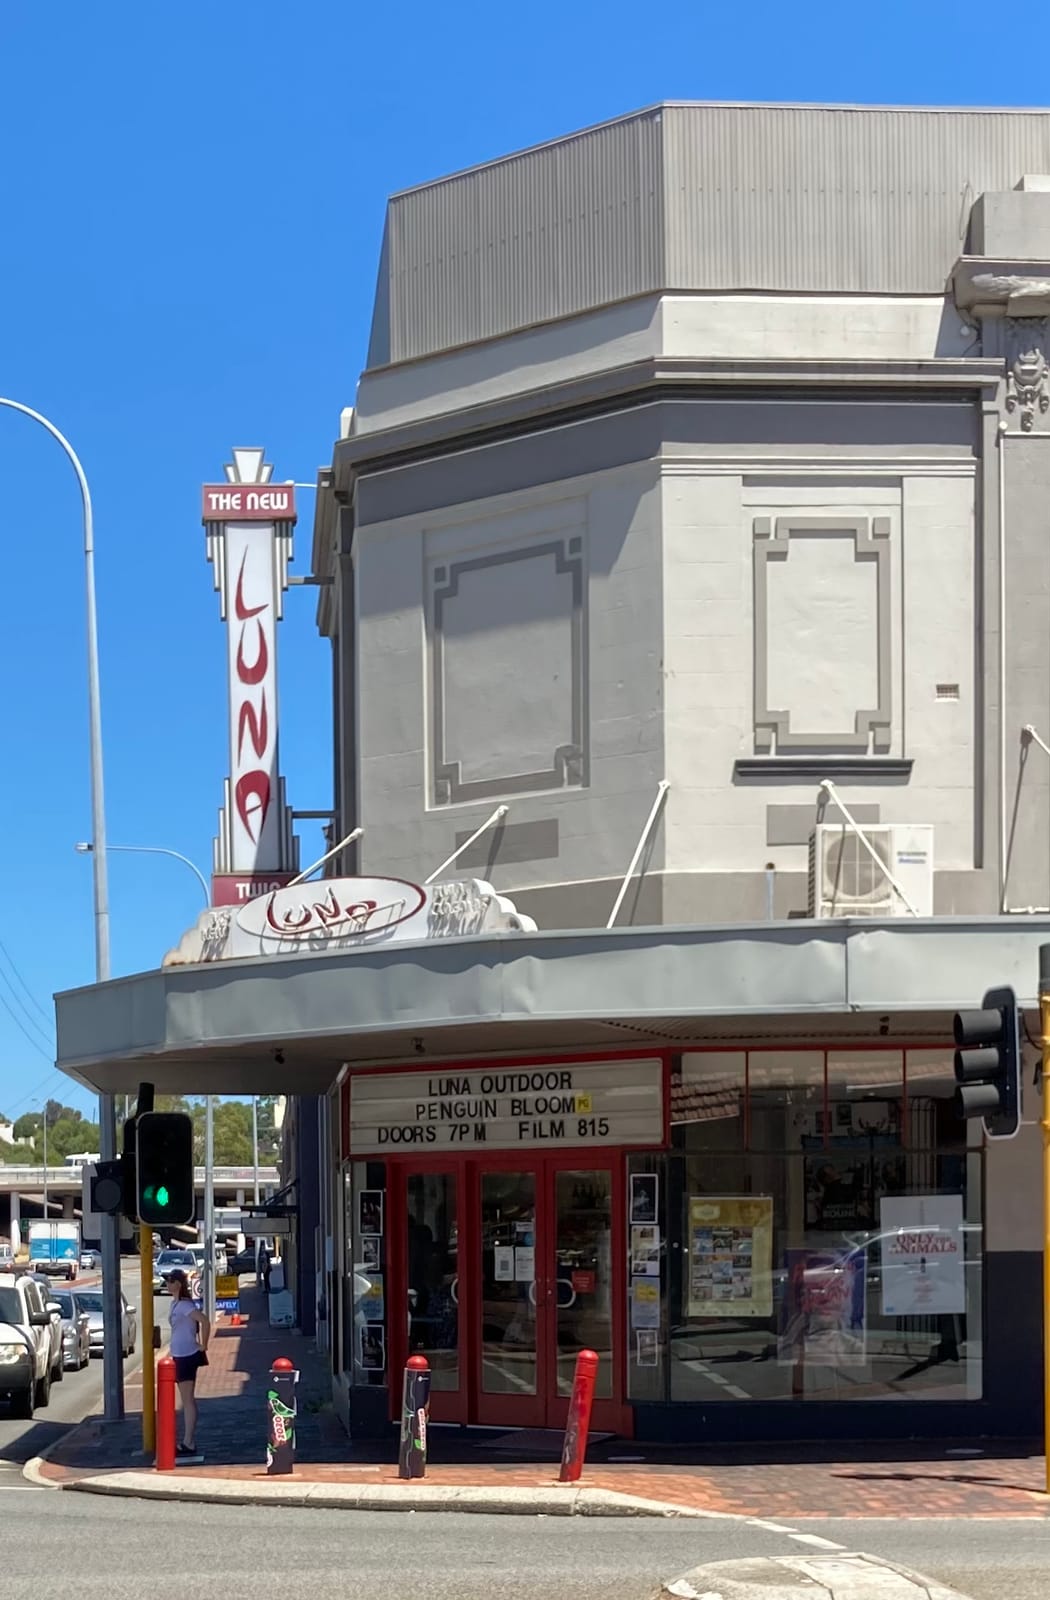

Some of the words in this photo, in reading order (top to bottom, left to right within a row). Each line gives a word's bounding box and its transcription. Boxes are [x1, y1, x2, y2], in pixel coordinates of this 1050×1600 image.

[208, 493, 241, 510] THE
[246, 492, 288, 510] NEW
[234, 543, 270, 846] LUNA
[266, 887, 396, 935] LUNA
[428, 1074, 471, 1097] LUNA
[480, 1071, 573, 1094] OUTDOOR
[415, 1099, 497, 1121] PENGUIN
[510, 1095, 576, 1117] BLOOM
[377, 1124, 436, 1145] DOORS
[448, 1122, 487, 1143] 7PM
[518, 1119, 565, 1140] FILM
[577, 1117, 609, 1138] 815
[888, 1241, 958, 1255] ANIMALS
[896, 1233, 934, 1245] ONLY
